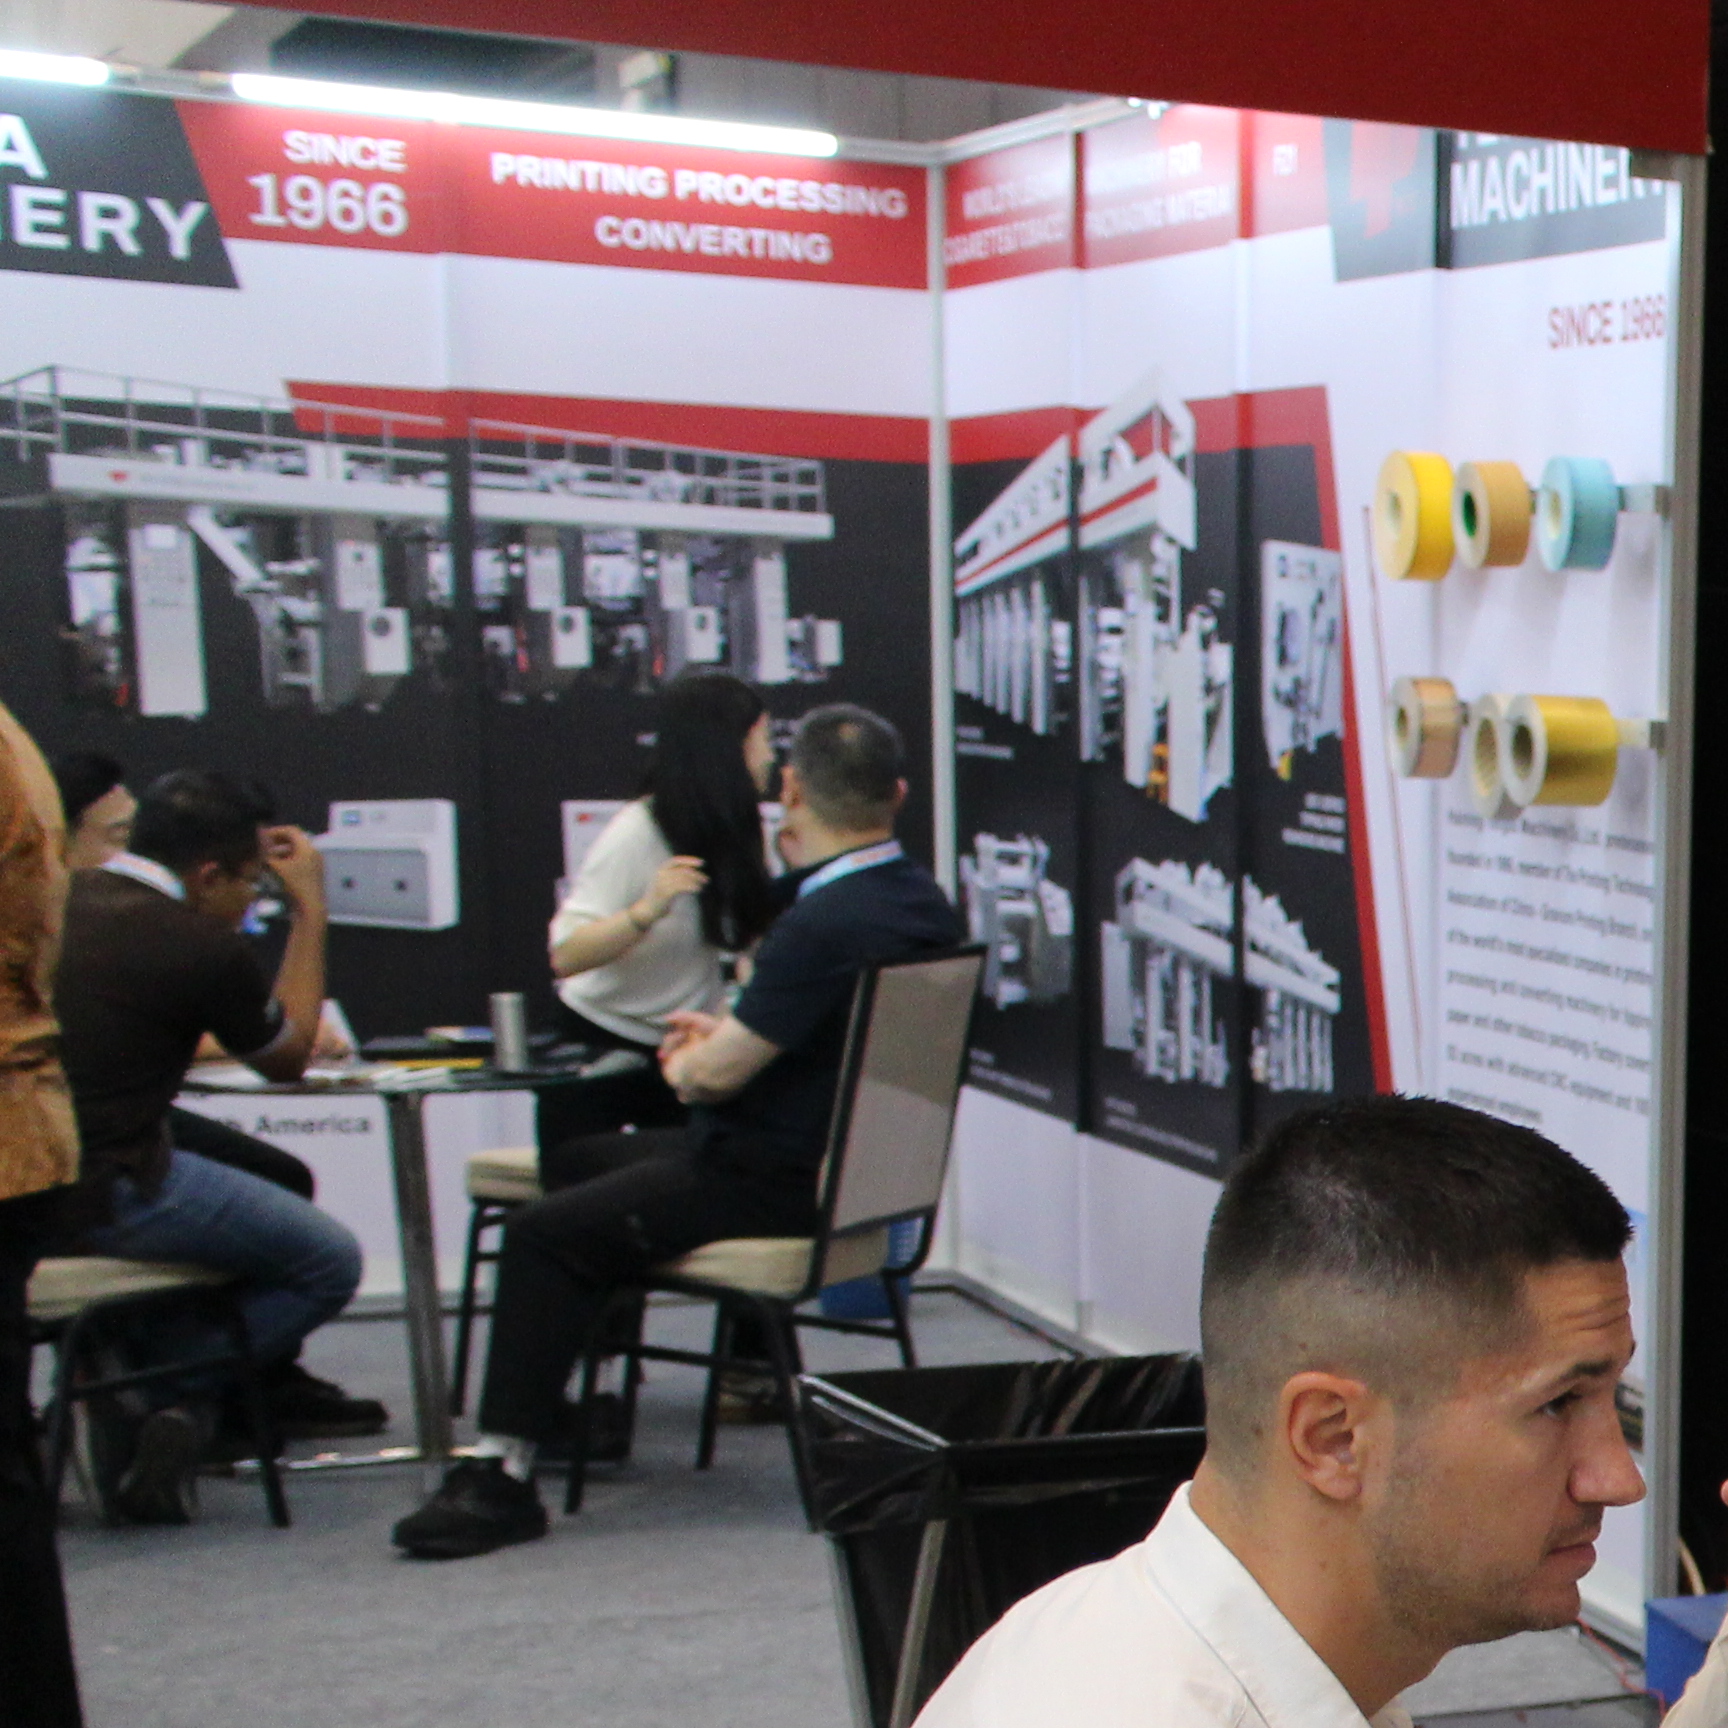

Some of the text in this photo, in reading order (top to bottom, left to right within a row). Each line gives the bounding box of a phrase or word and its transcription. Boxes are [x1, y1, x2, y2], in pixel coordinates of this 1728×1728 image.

[282, 130, 408, 172] SINCE
[247, 173, 409, 237] 1966
[490, 152, 669, 199] PRINTING
[674, 169, 909, 218] PROCESSING
[1451, 140, 1663, 229] MACHINE
[10, 184, 211, 261] ERY
[595, 215, 834, 264] CONVERTING
[1550, 294, 1665, 350] SINCE 1966
